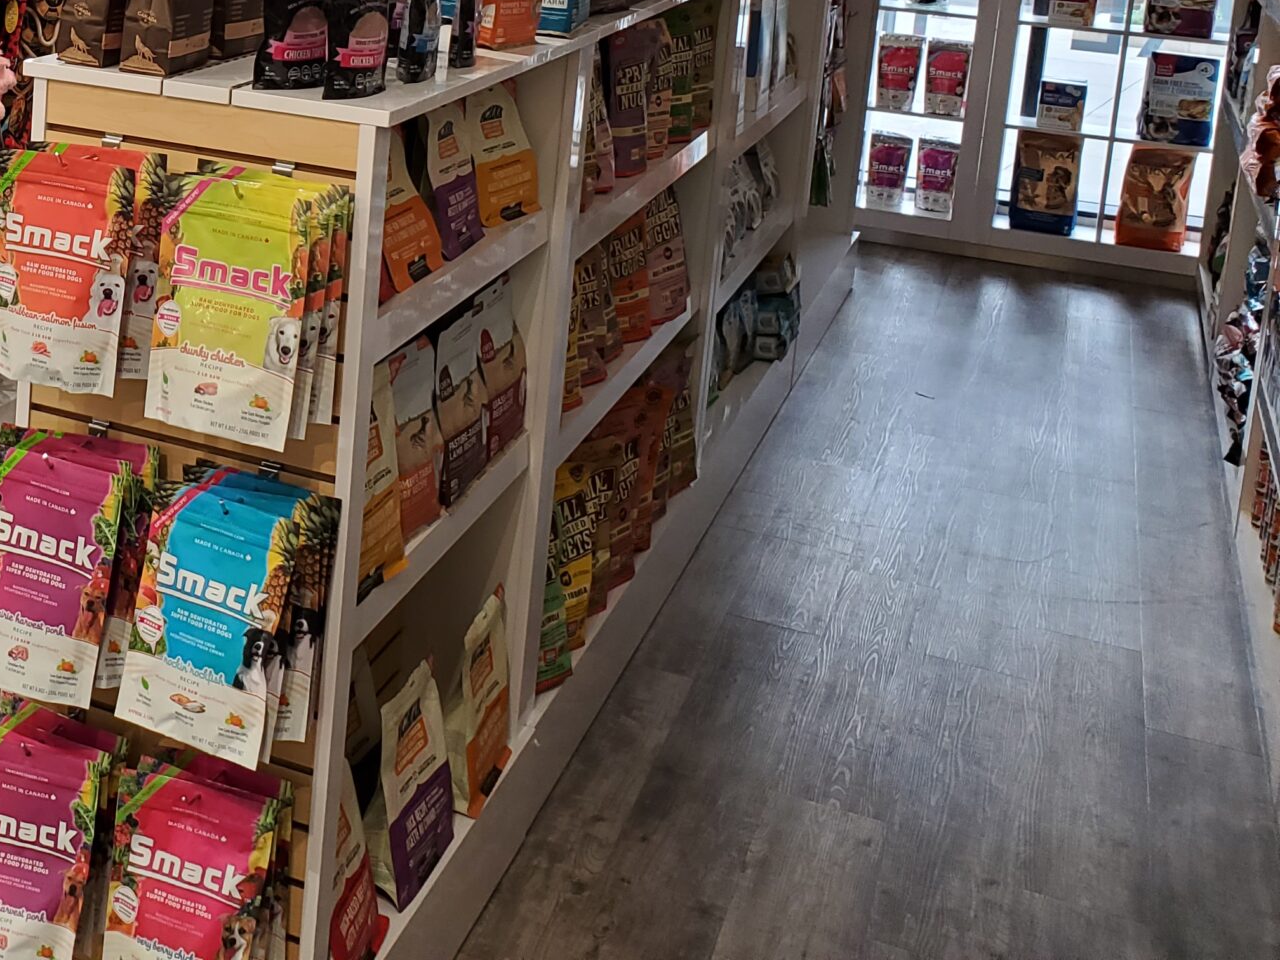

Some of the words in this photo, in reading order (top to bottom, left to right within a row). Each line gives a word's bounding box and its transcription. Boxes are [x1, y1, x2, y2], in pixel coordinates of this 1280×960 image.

[880, 63, 915, 74] Smack
[929, 67, 964, 79] Smack
[37, 194, 51, 202] MADE
[62, 198, 86, 209] CANADA
[5, 212, 113, 261] Smack
[171, 244, 292, 300] Smack
[26, 495, 41, 505] MADE
[6, 565, 21, 575] SUPER
[22, 570, 38, 580] FOOD
[50, 579, 66, 590] DOGS
[11, 562, 24, 571] RAW
[25, 565, 62, 582] DEHYDRATED
[156, 551, 269, 620] Smack
[15, 612, 44, 632] harvest
[45, 626, 65, 637] pork
[24, 789, 49, 800] CANADA
[4, 858, 20, 868] FOOD
[33, 865, 49, 875] DOGS
[129, 834, 247, 900] Smack
[25, 911, 47, 924] pork
